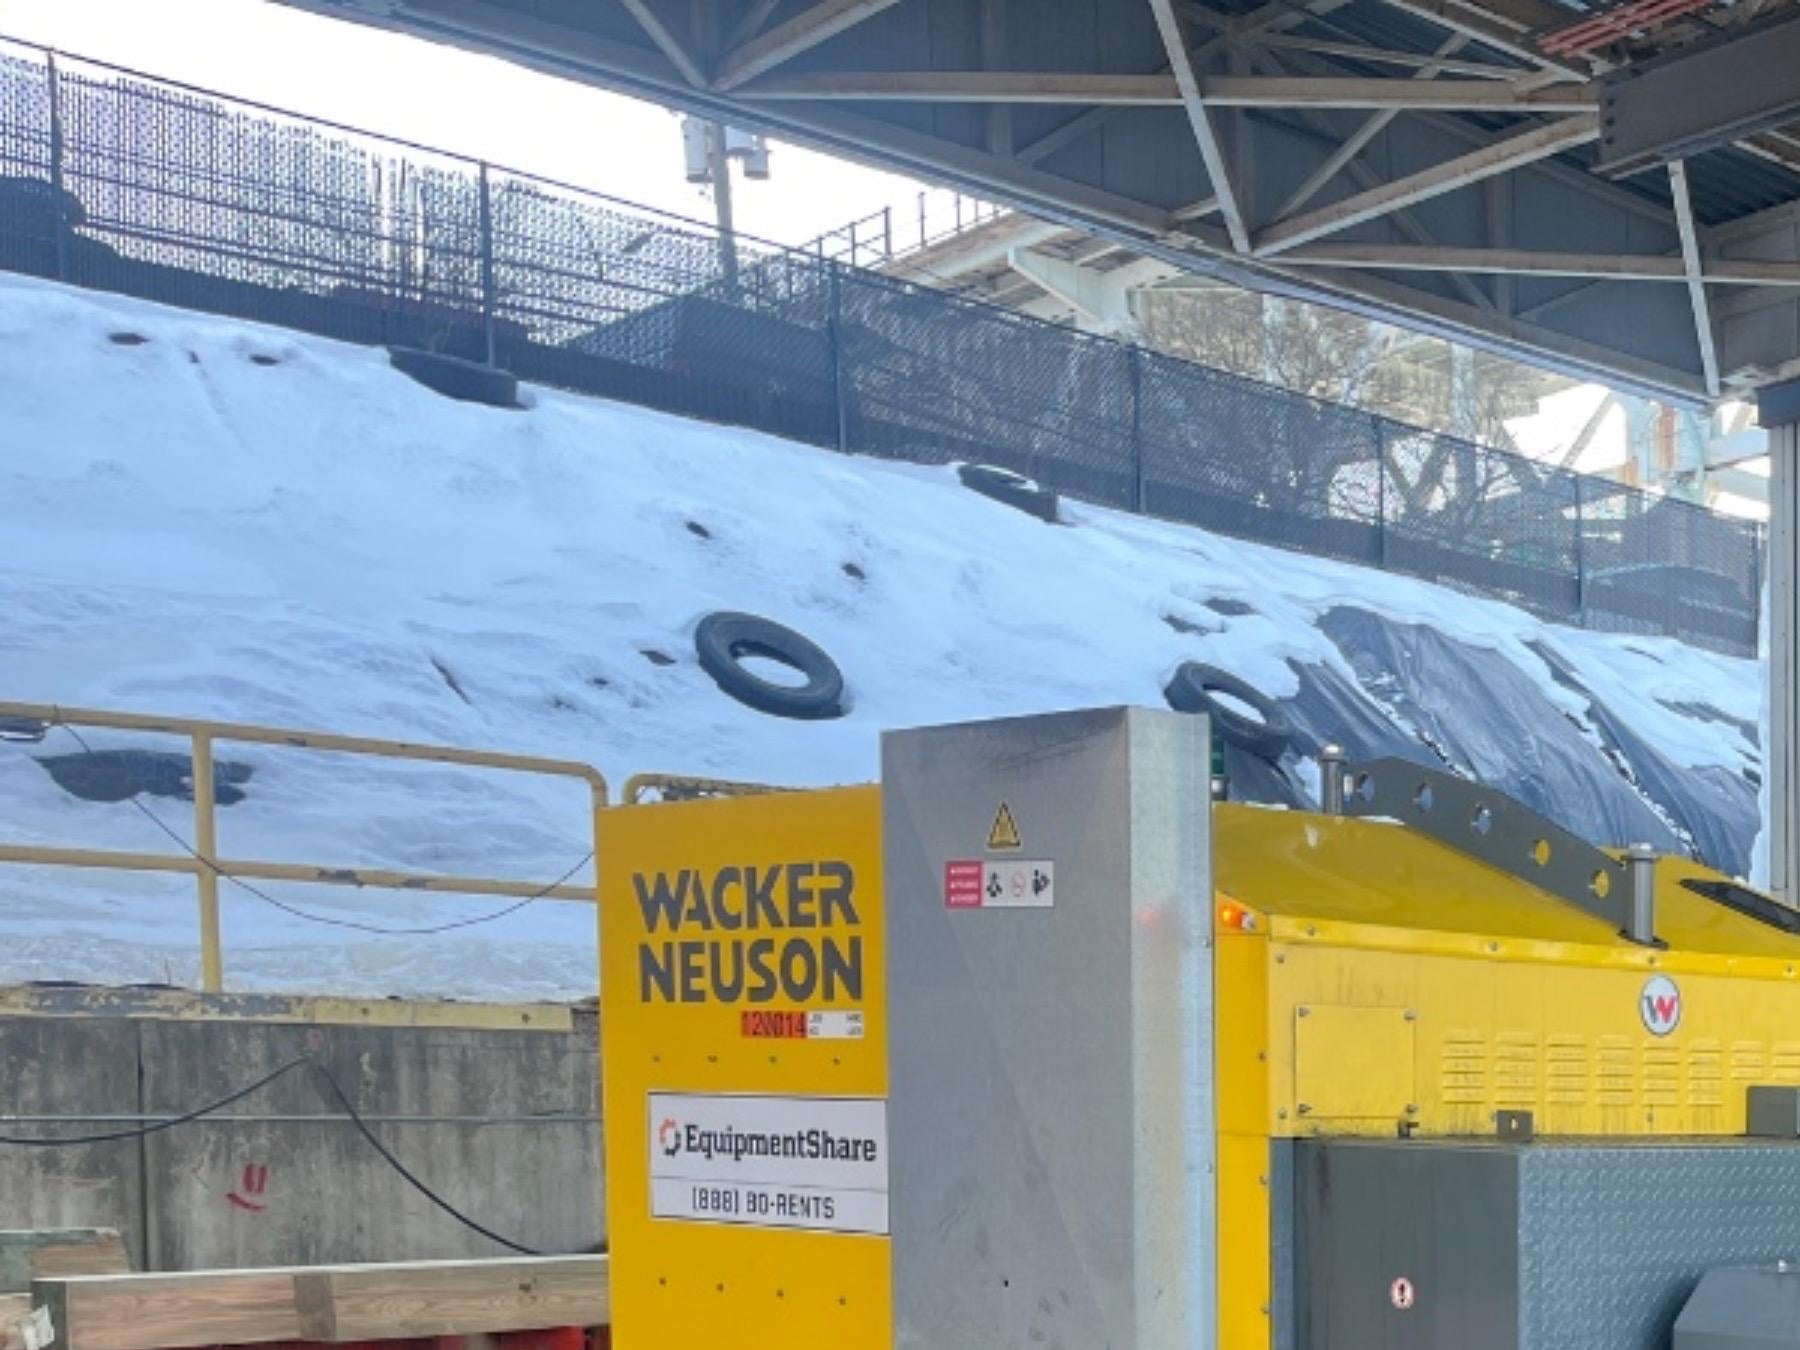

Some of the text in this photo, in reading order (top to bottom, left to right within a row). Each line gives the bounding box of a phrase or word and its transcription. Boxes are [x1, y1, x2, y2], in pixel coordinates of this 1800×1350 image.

[632, 860, 861, 934] WACKER
[638, 935, 863, 1003] NEUSON
[685, 1124, 877, 1162] EquipmentShare
